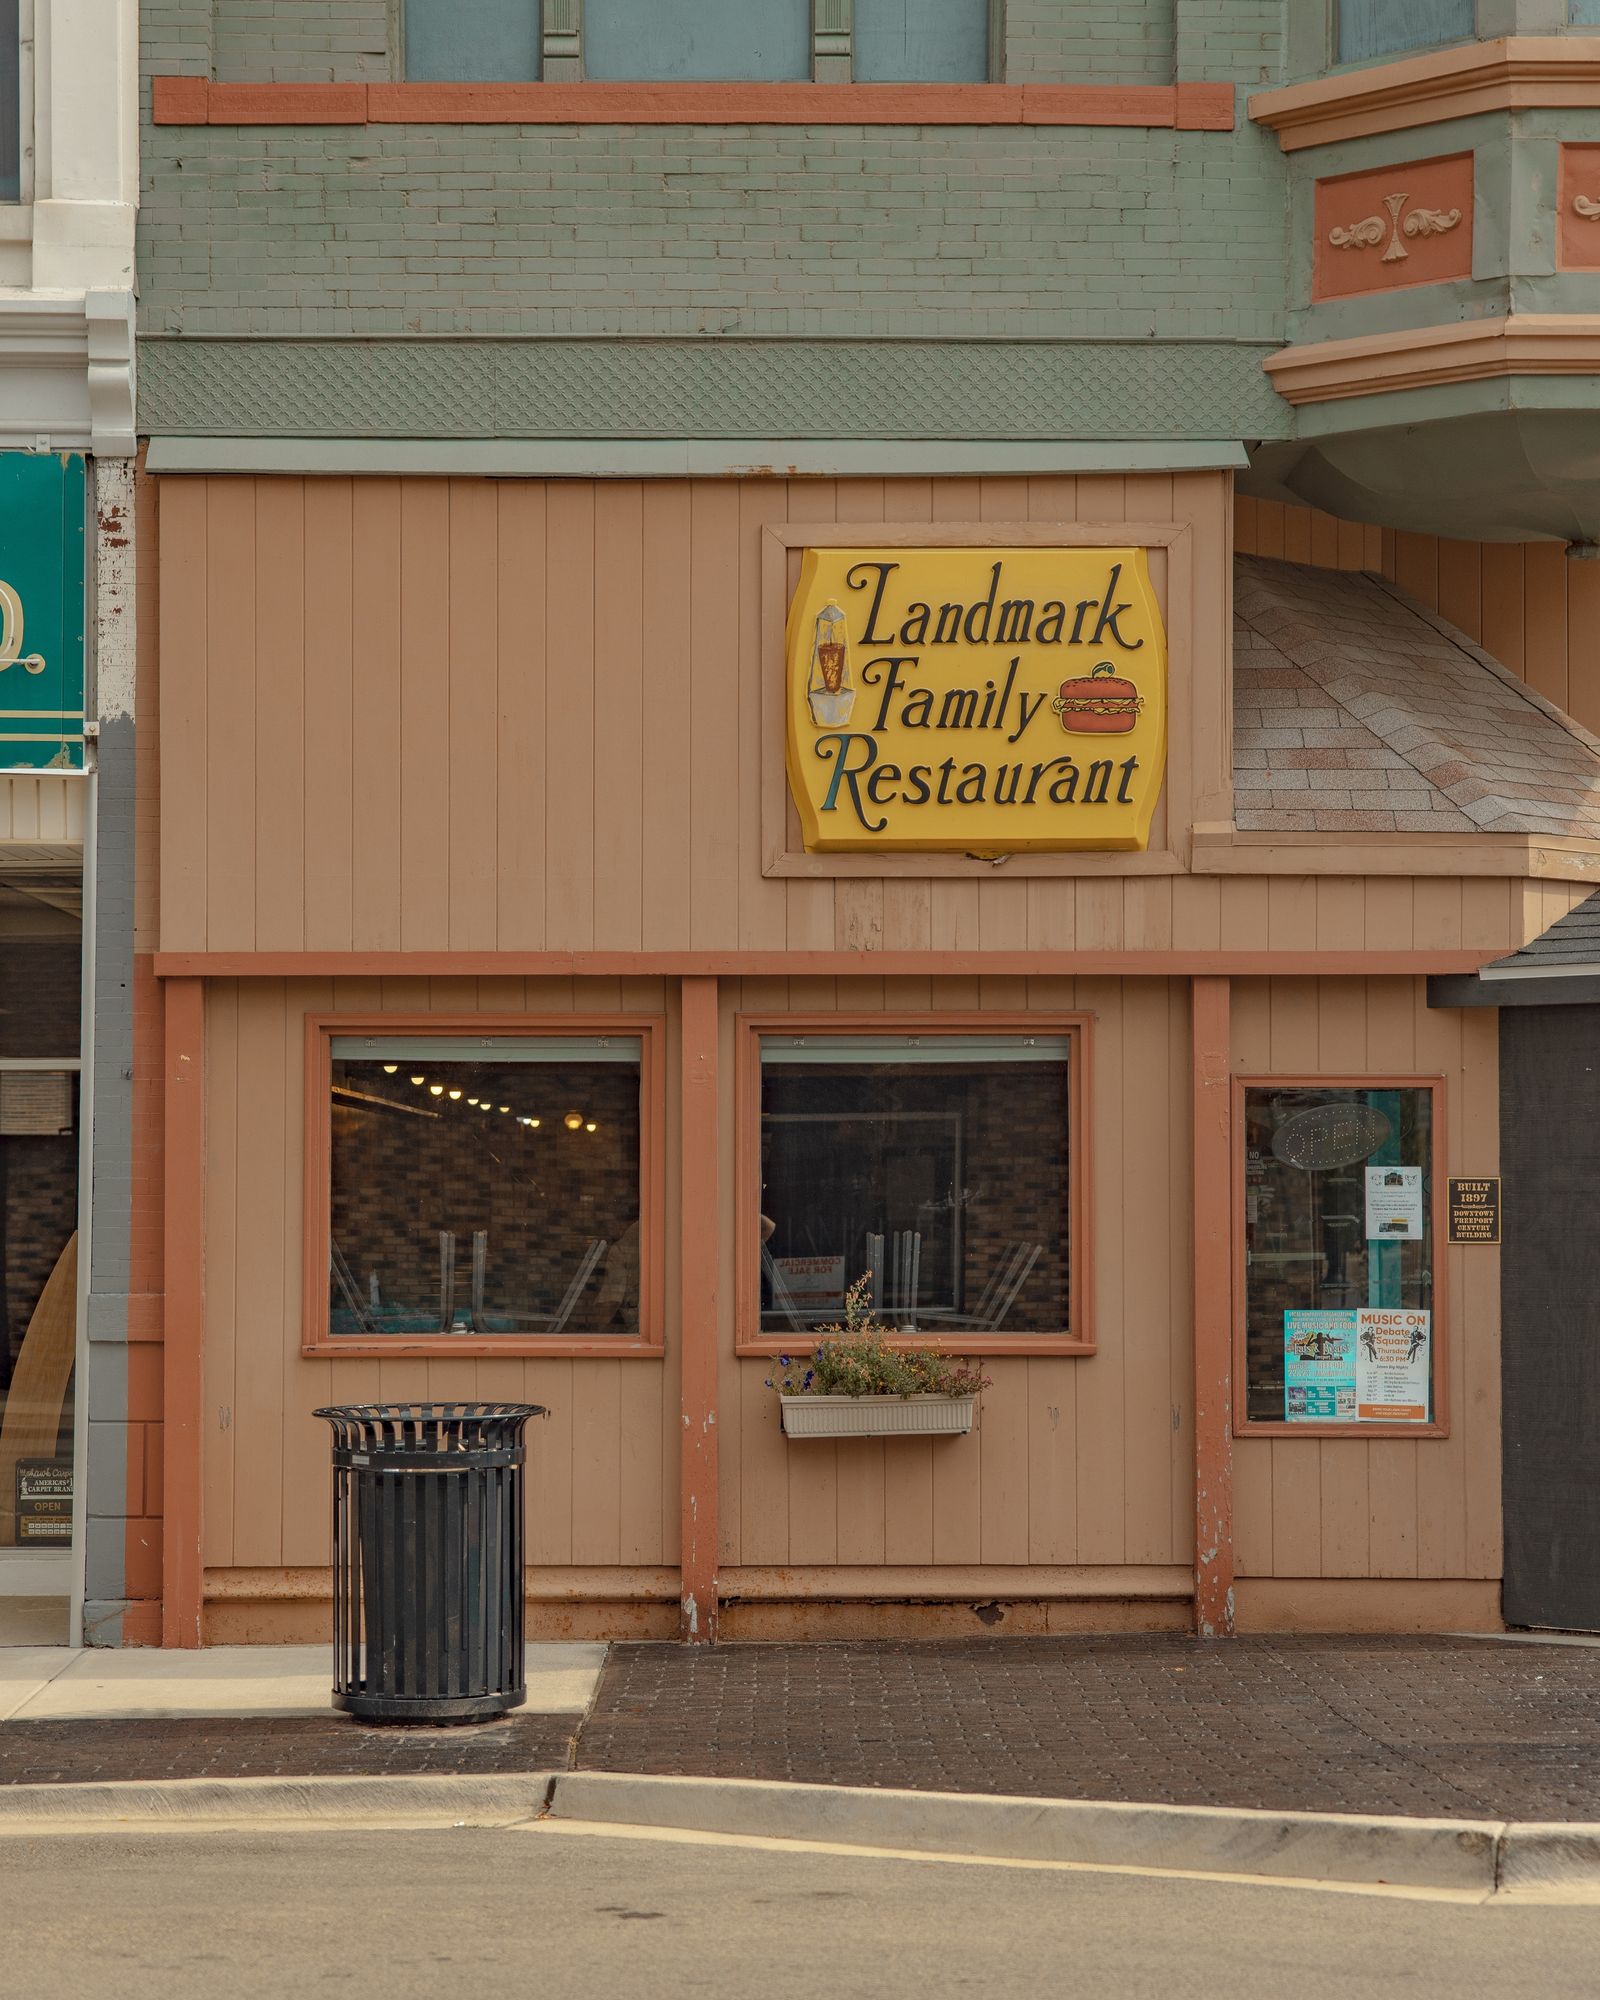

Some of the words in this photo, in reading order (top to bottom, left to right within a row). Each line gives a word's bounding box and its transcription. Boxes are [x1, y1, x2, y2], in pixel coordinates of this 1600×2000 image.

[846, 561, 1144, 650] Landmark
[862, 656, 1048, 743] Family
[815, 733, 1140, 832] Restaurant
[1286, 1115, 1376, 1159] OPEN
[1248, 1151, 1260, 1160] NO
[1457, 1182, 1490, 1191] BUILT
[1461, 1193, 1487, 1202] 1897
[1361, 1314, 1402, 1325] MUSIC
[1406, 1315, 1426, 1325] ON
[1302, 1321, 1323, 1329] MUSIC
[1376, 1327, 1410, 1335] Debate
[1376, 1336, 1410, 1346] Square
[1377, 1347, 1409, 1355] Thursday
[20, 1468, 52, 1478] Mohawk
[53, 1469, 73, 1479] Carpe
[34, 1502, 61, 1511] OPEN
